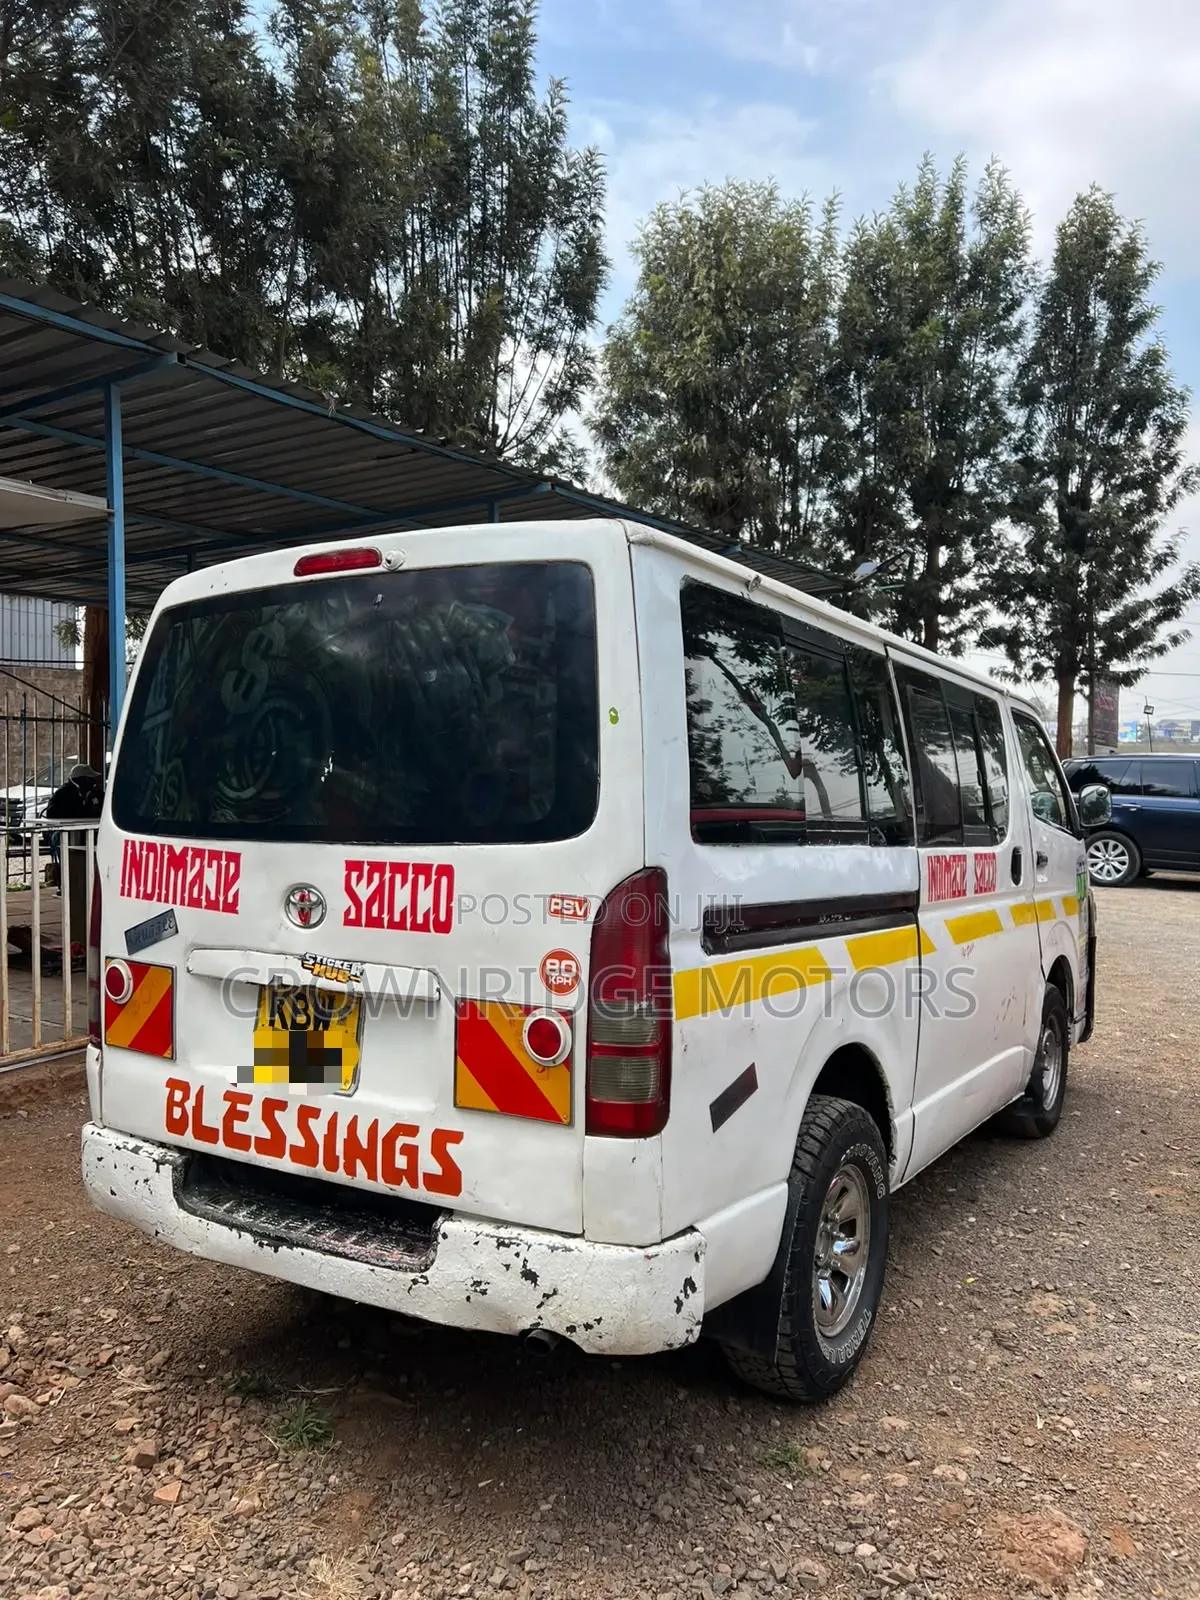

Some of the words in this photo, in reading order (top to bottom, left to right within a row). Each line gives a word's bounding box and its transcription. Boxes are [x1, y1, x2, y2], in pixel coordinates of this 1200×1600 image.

[550, 897, 588, 916] PSV
[302, 952, 364, 976] STICKER
[312, 963, 351, 983] HUB
[545, 958, 577, 978] 80
[548, 976, 572, 986] KPH
[165, 1077, 464, 1197] BLESSINGS
